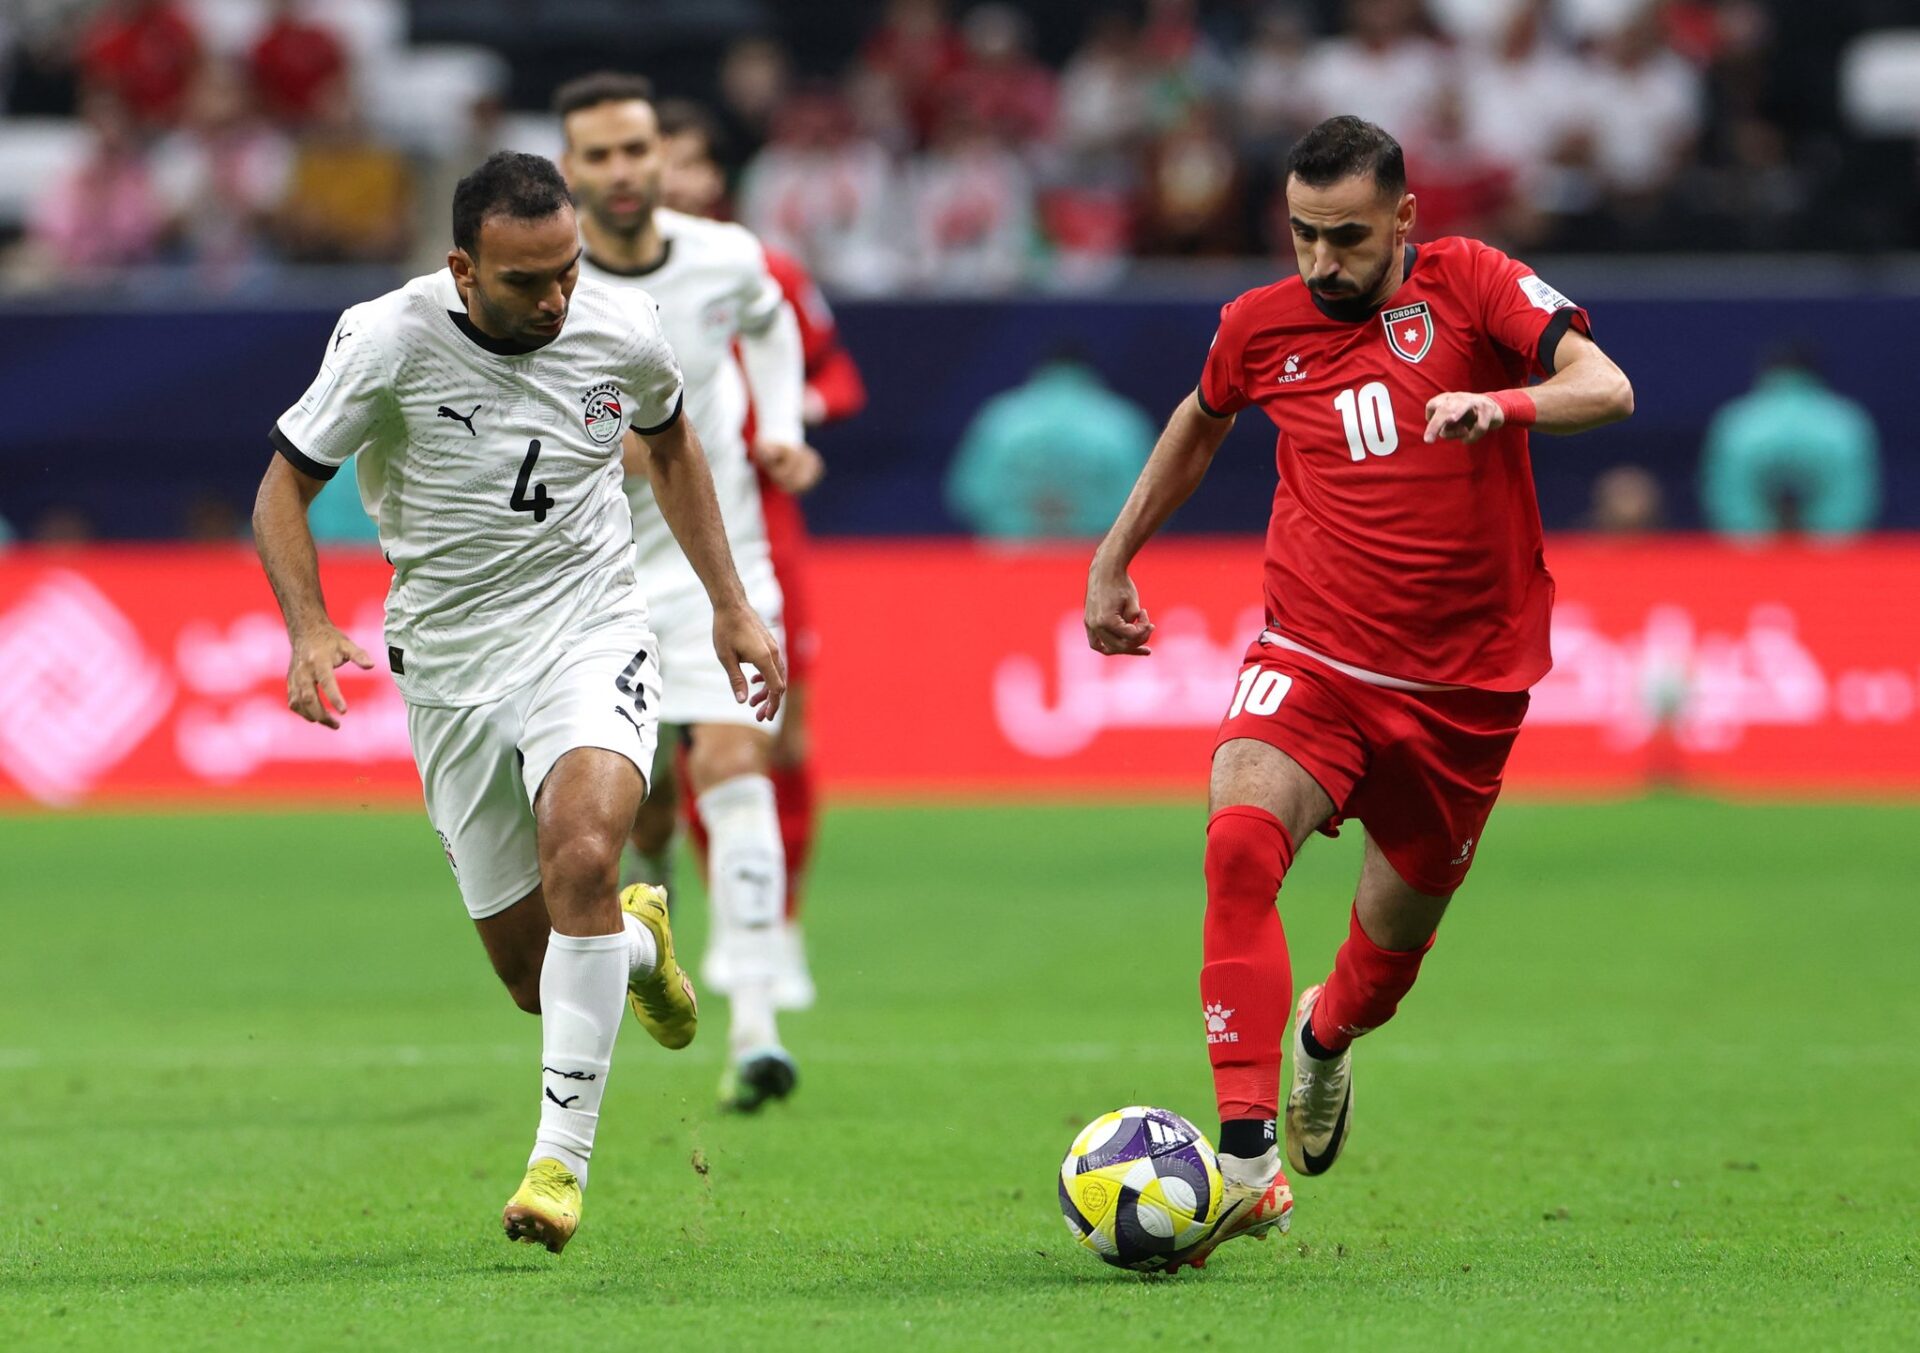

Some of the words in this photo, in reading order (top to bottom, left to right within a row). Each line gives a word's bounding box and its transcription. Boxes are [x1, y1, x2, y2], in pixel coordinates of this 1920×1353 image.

[1389, 305, 1422, 321] JORDAN
[1277, 370, 1307, 384] KELME
[1334, 382, 1398, 461] 10
[509, 439, 555, 523] 4
[615, 649, 648, 714] 4
[1229, 665, 1292, 720] 10
[1206, 1031, 1239, 1044] ELME
